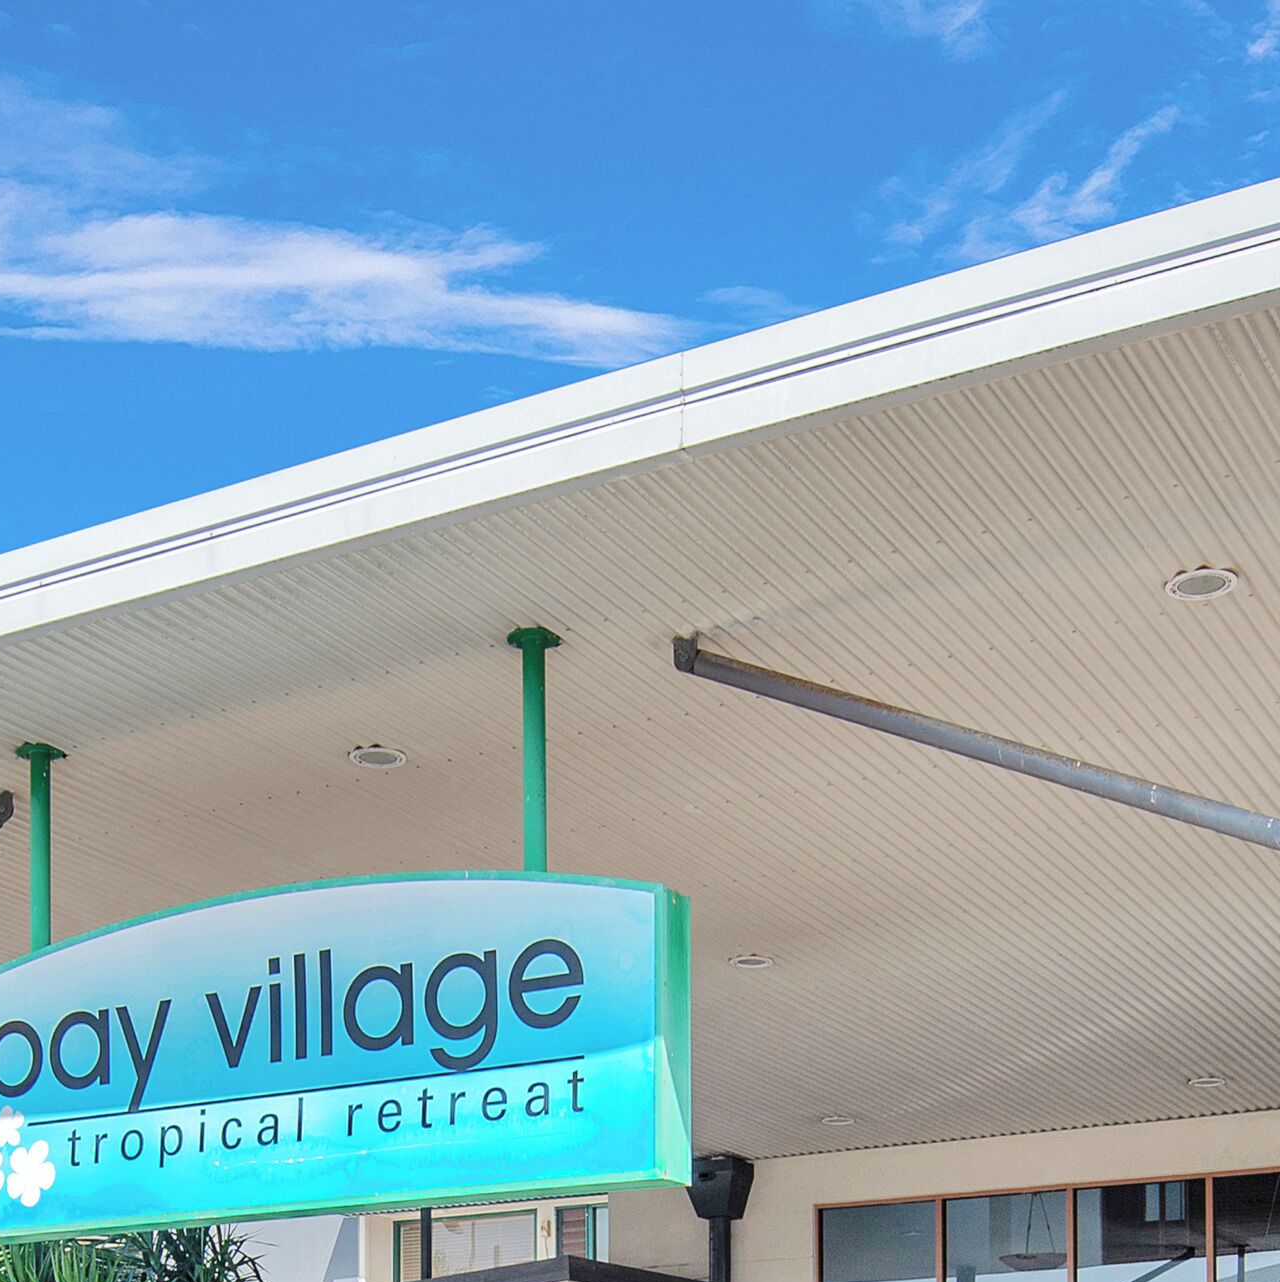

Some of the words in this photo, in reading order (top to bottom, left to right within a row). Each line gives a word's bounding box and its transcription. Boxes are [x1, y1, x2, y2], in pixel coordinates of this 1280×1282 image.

[206, 938, 584, 1073] village
[68, 1097, 303, 1169] tropical
[347, 1069, 585, 1138] retreat
